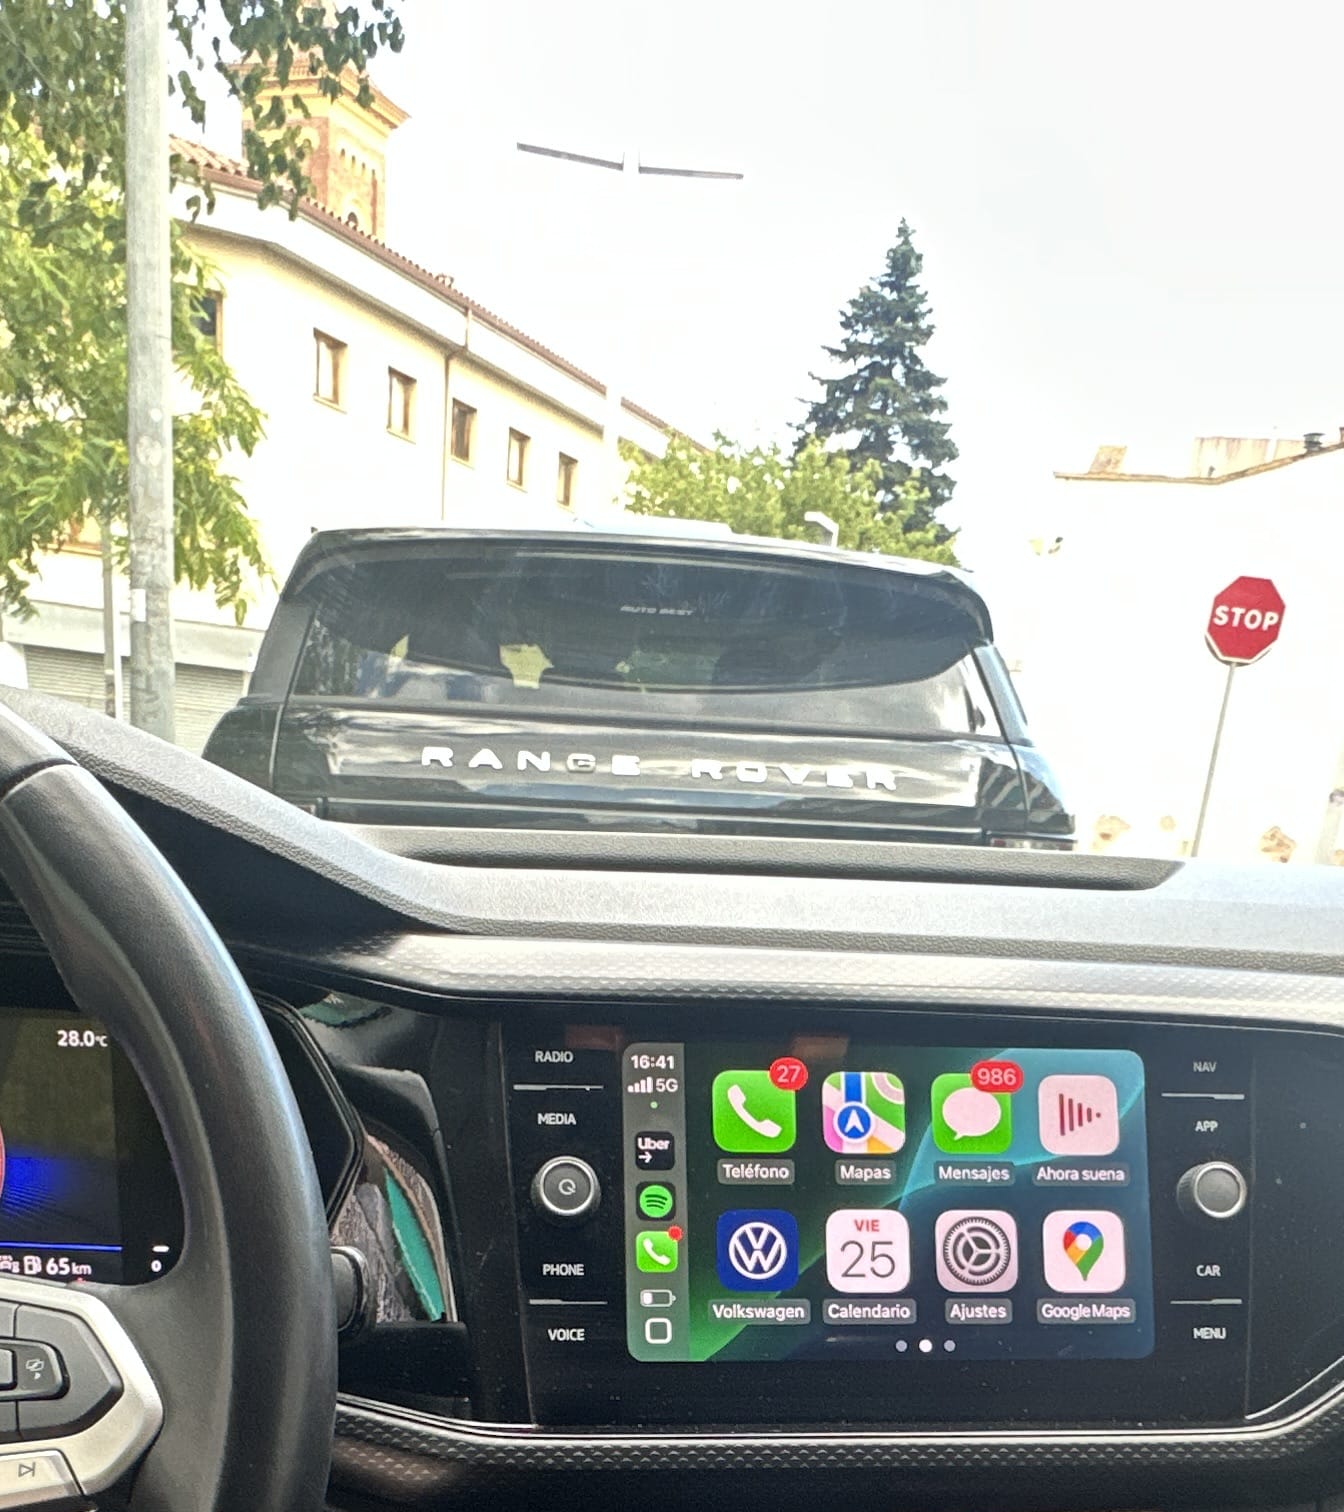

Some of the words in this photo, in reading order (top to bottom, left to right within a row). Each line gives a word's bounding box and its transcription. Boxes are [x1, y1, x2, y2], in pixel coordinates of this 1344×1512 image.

[1213, 604, 1280, 632] STOP
[420, 746, 642, 778] RANGE
[690, 758, 897, 791] ROVER
[535, 1051, 574, 1063] RADIO
[631, 1055, 675, 1070] 16:41
[776, 1065, 802, 1083] 27
[1193, 1061, 1217, 1073] NAV
[977, 1068, 1017, 1086] 986
[656, 1078, 678, 1092] 5G
[537, 1113, 576, 1126] MEDIA
[1195, 1120, 1218, 1133] APP
[637, 1137, 670, 1150] Uber
[722, 1164, 790, 1180] Teléfono
[840, 1165, 891, 1182] Mapas
[938, 1166, 1010, 1182] Mensajes
[1036, 1166, 1080, 1181] Ahora
[1082, 1168, 1125, 1182] suena
[854, 1219, 880, 1232] VIE
[46, 1257, 71, 1275] 65
[71, 1259, 92, 1275] km
[150, 1260, 162, 1273] 0
[840, 1241, 896, 1278] 25
[542, 1264, 585, 1277] PHONE
[1196, 1264, 1221, 1277] CAR
[712, 1303, 805, 1321] Volkswagen
[827, 1304, 911, 1319] Calendario
[950, 1304, 1007, 1321] Ajustes
[1041, 1303, 1091, 1321] Google
[1091, 1303, 1131, 1321] Maps
[548, 1328, 585, 1341] VOICE
[1193, 1326, 1226, 1340] MENU
